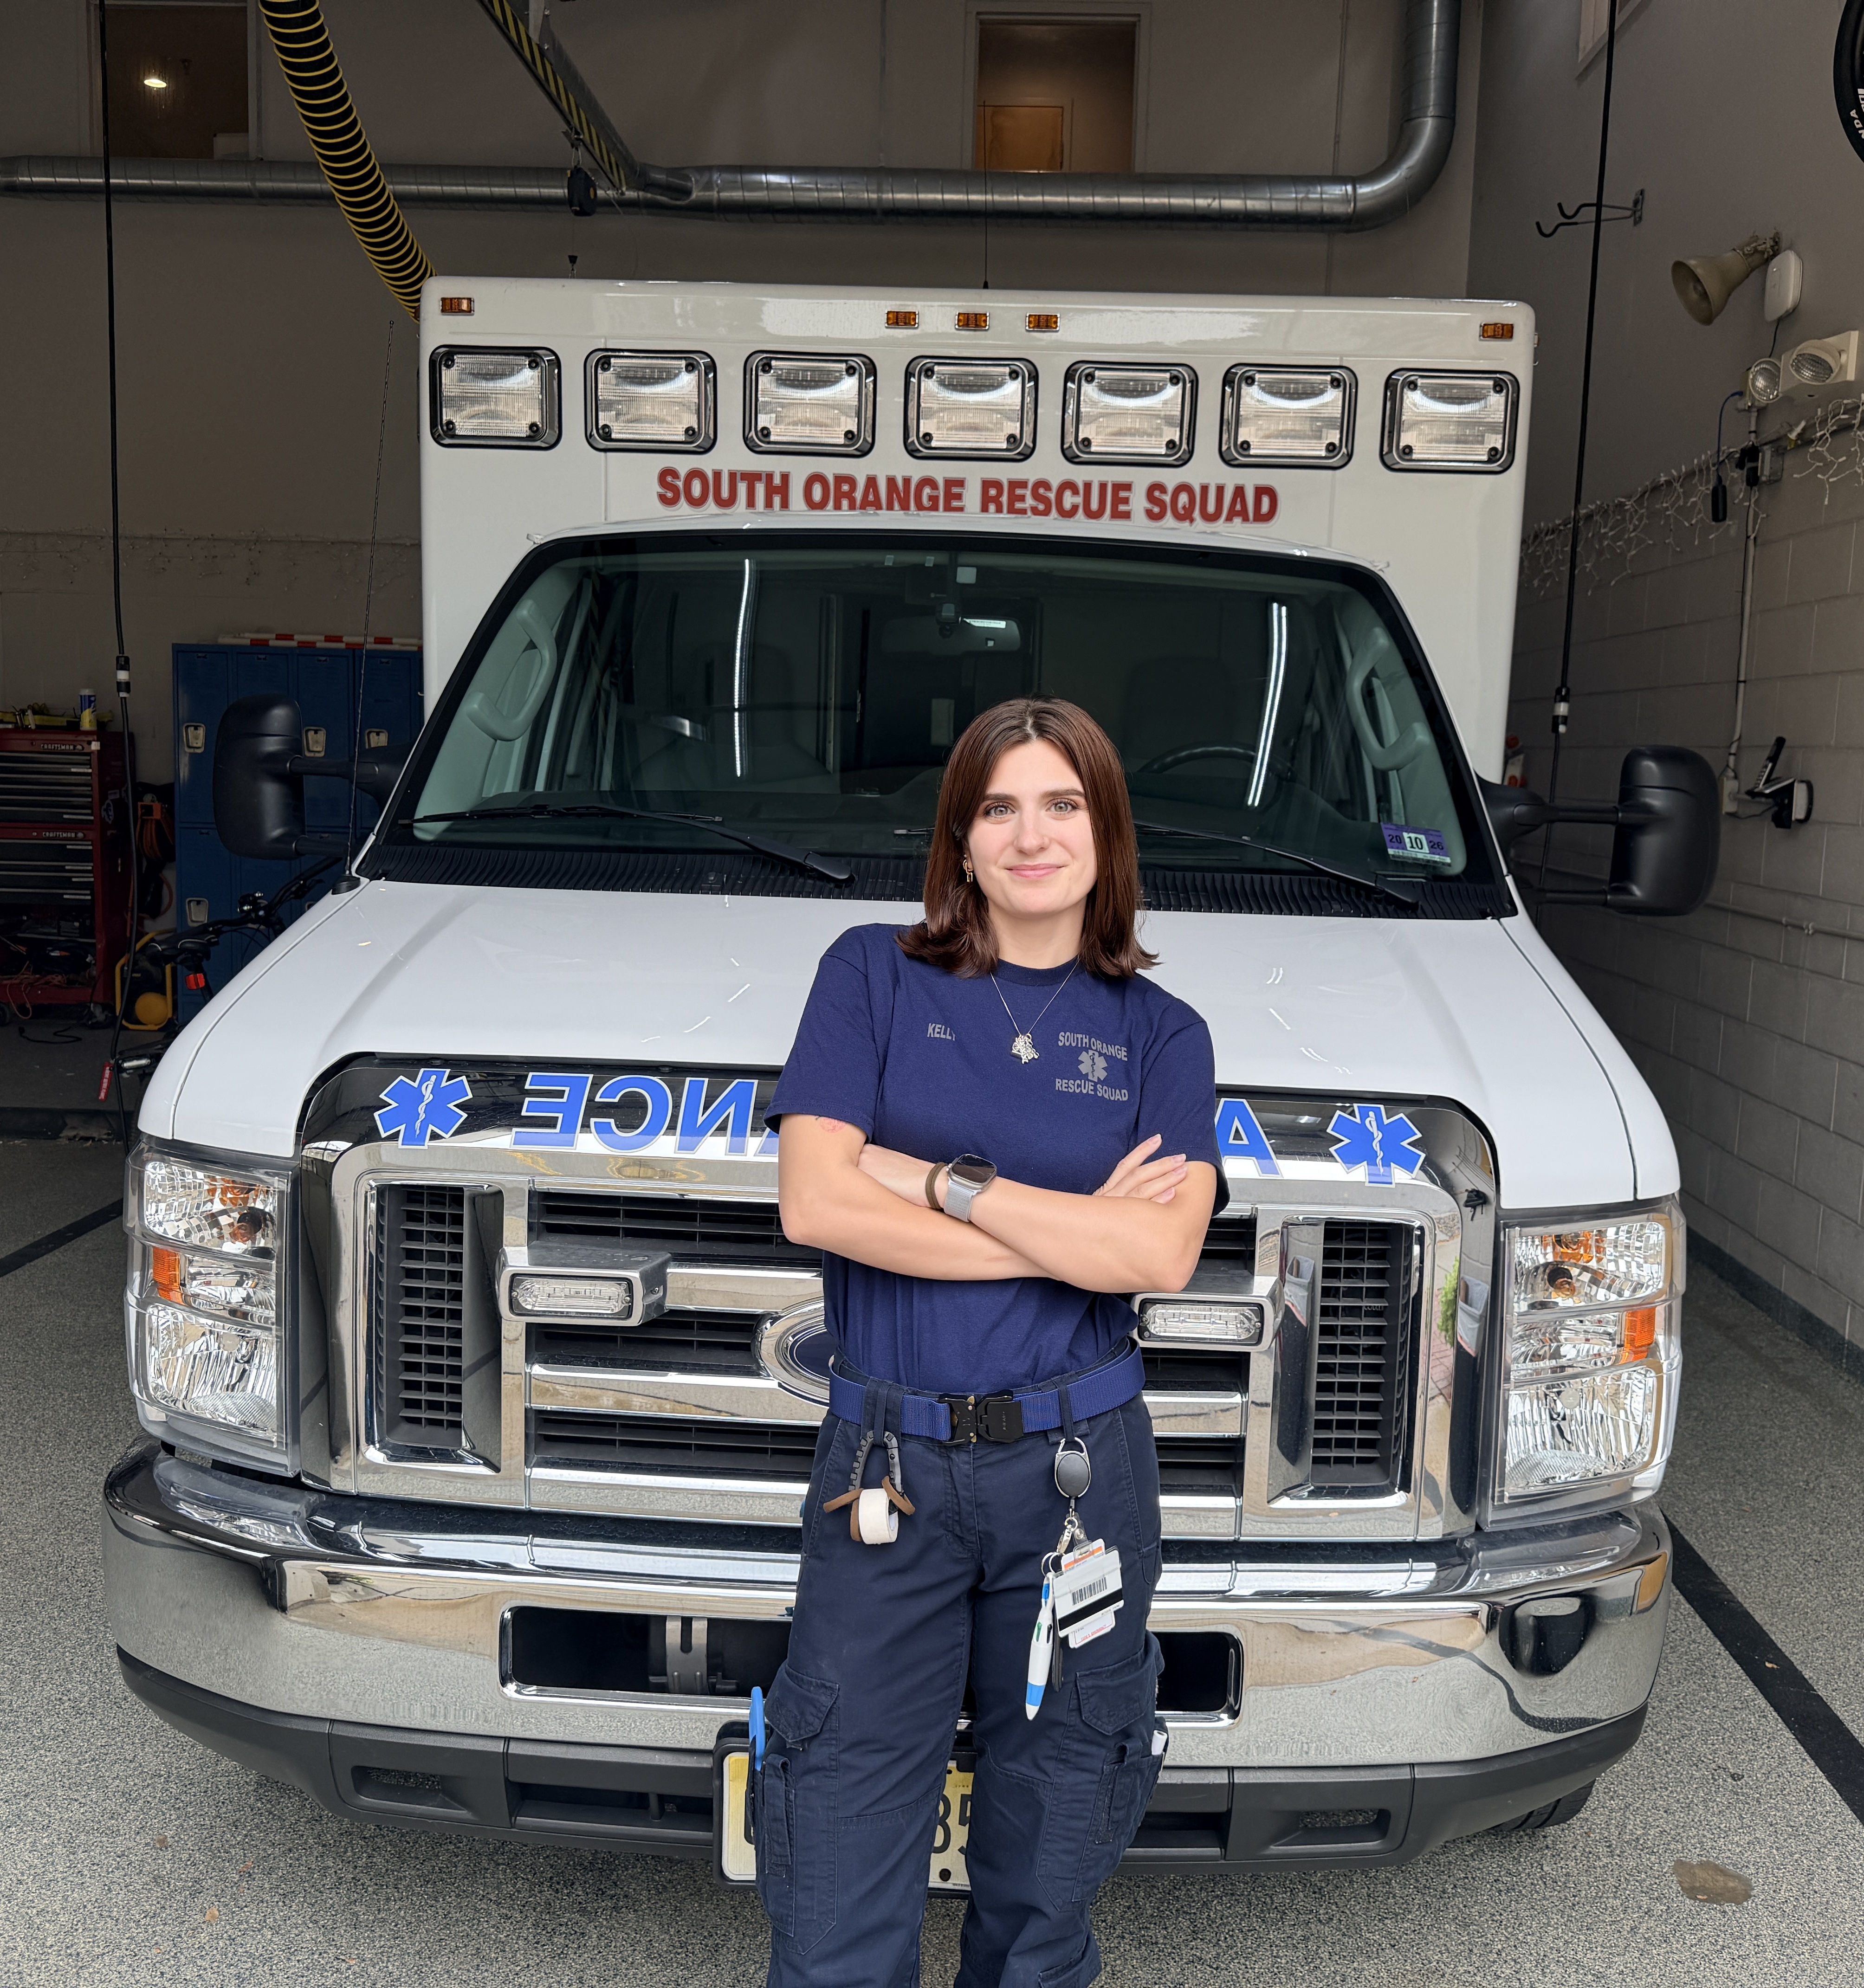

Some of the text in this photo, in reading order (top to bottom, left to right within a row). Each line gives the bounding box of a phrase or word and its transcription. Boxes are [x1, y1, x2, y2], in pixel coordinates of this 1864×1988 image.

[657, 467, 1279, 524] SOUTH ORANGE RESCUE SQUAD
[1388, 834, 1444, 850] 20 10 26
[1058, 1032, 1128, 1061] SOUTH ORANGE
[1055, 1078, 1128, 1101] RESCUE SQUAD
